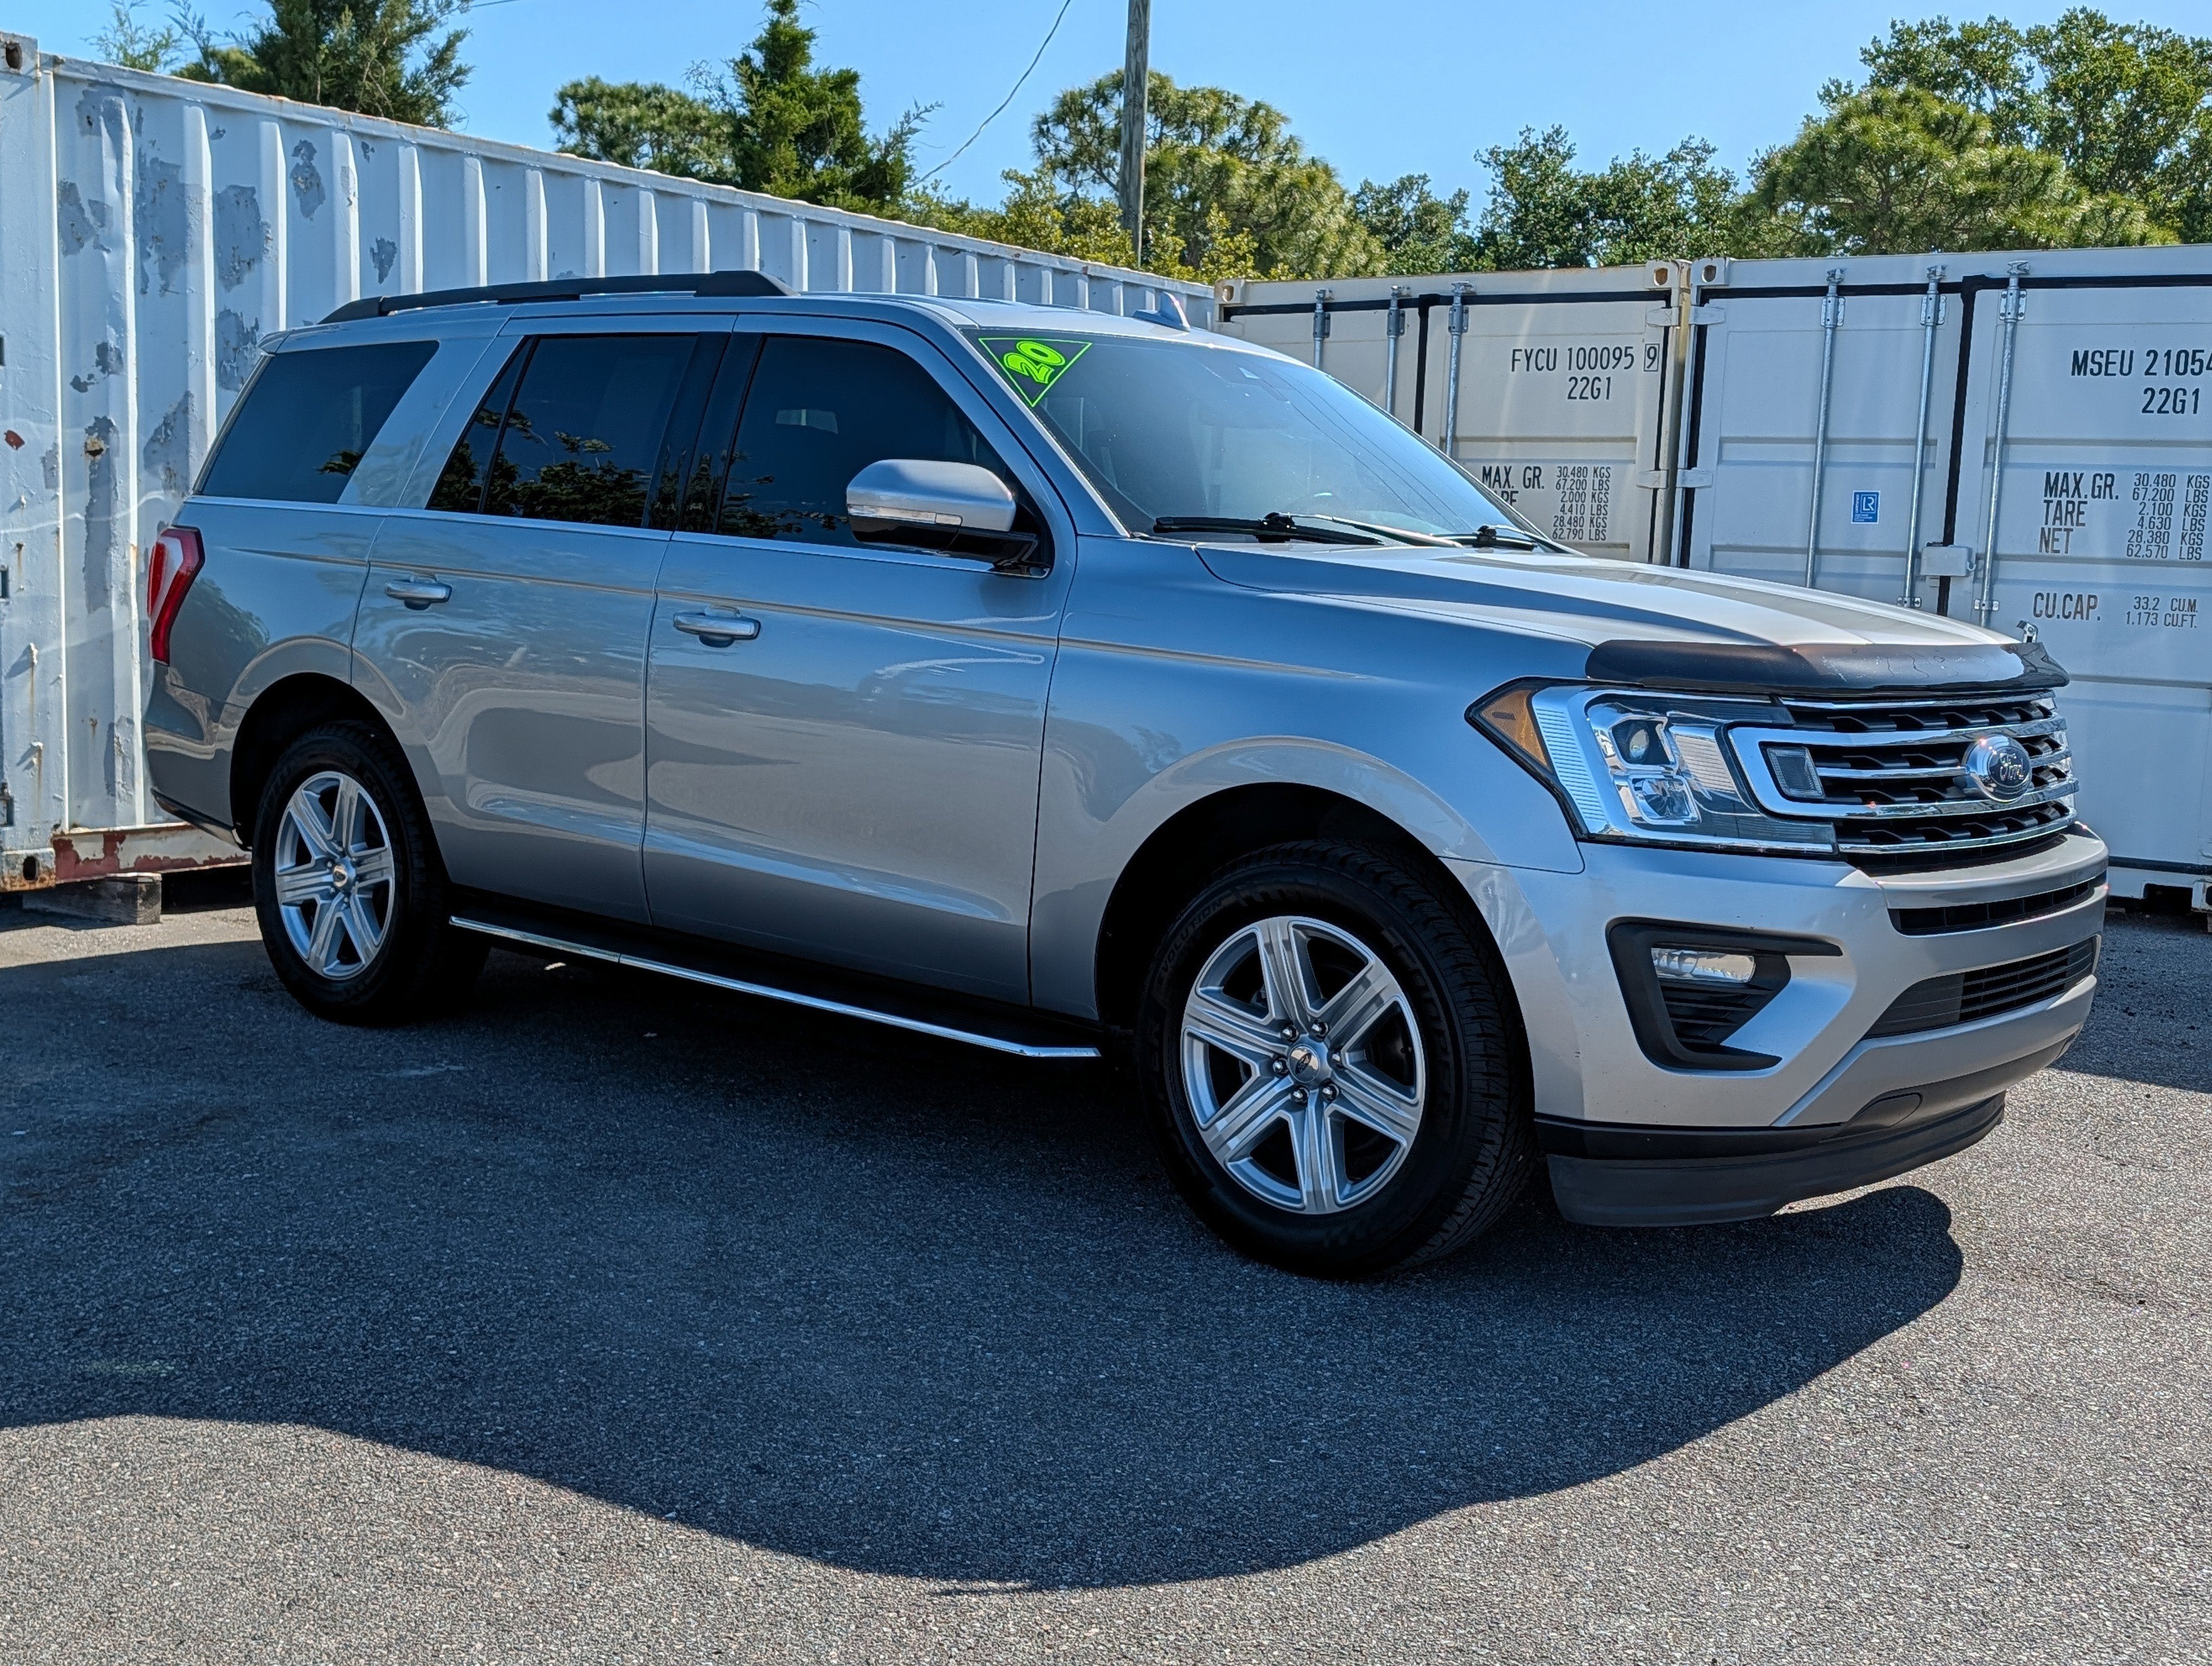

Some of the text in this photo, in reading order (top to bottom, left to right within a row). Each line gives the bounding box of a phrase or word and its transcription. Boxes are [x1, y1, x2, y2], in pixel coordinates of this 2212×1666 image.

[1003, 341, 1065, 384] 20
[1511, 346, 1657, 372] FYCU 100095 9
[2071, 350, 2134, 376] MSEU
[1567, 376, 1611, 400] 22G1
[2142, 387, 2200, 414] 22G1
[1482, 465, 1545, 489] MAX. GR.
[1556, 465, 1611, 478] 30.480 KGS
[1555, 478, 1610, 491] 67.200 LBS
[2187, 475, 2210, 489] KGS
[1591, 491, 1609, 503] KGS
[2185, 489, 2209, 503] LBS
[1590, 504, 1608, 516] LBS
[1862, 496, 1875, 511] LR
[2183, 503, 2207, 517] KGS
[2043, 499, 2088, 527] TARE
[1589, 516, 1607, 528] KGS
[2182, 517, 2205, 531] LBS
[1588, 529, 1606, 541] LBS
[2039, 527, 2074, 554] NET
[2180, 532, 2204, 546] KGS
[2179, 546, 2202, 560] LBS
[2133, 596, 2160, 611] 33.2
[1157, 899, 1222, 986] EVOLUTION
